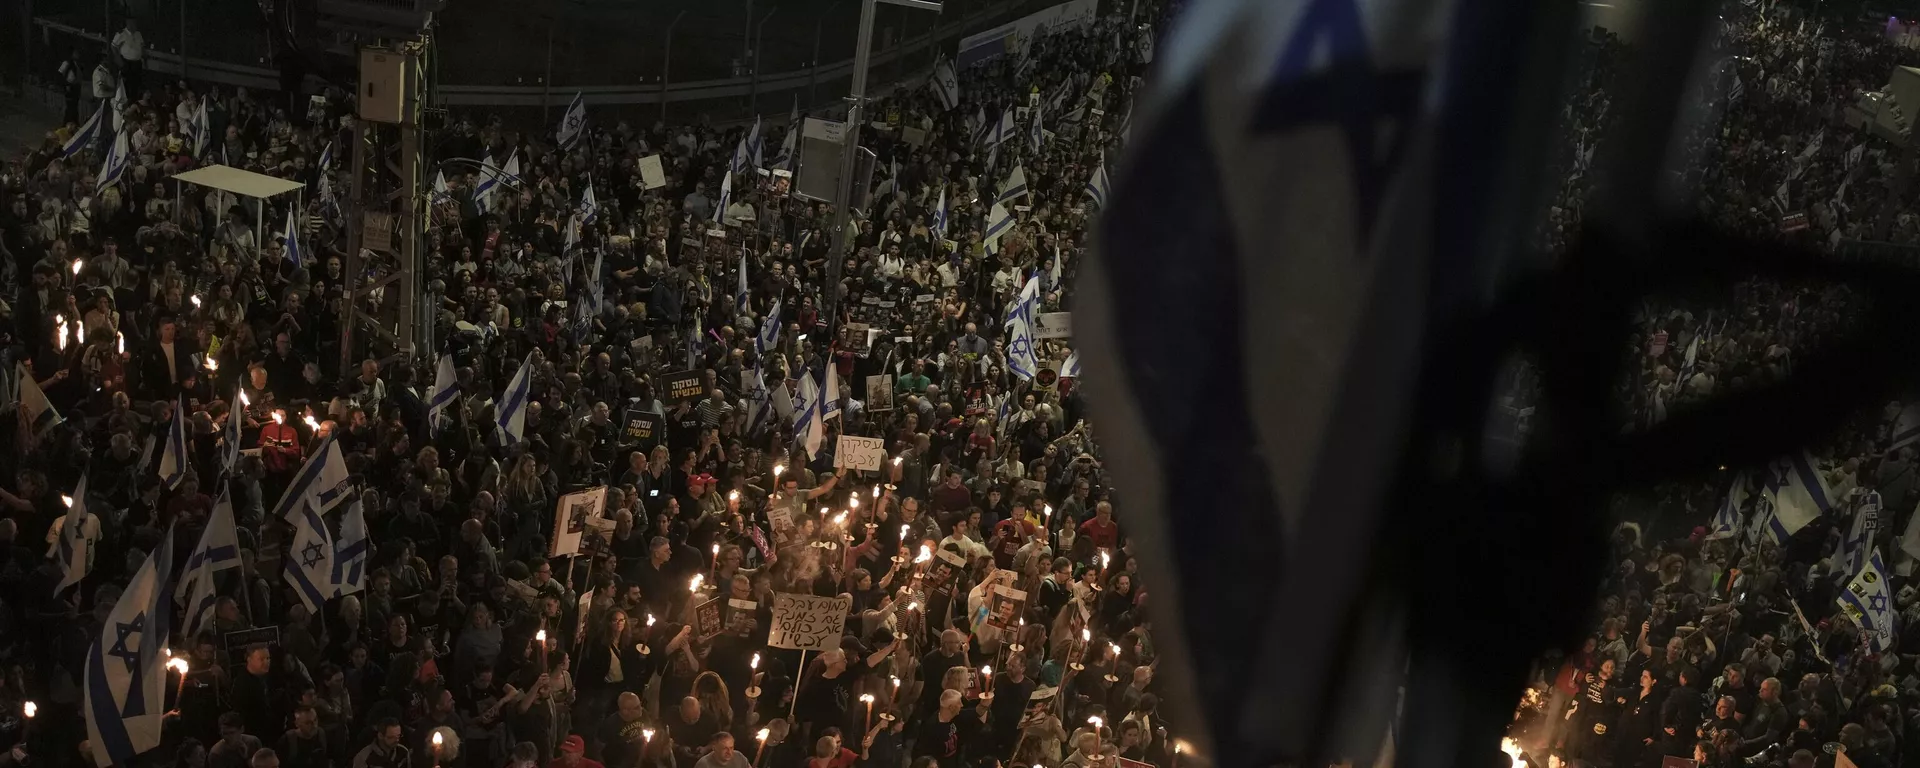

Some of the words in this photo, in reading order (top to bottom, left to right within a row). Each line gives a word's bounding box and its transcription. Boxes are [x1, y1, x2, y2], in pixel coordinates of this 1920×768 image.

[671, 377, 700, 390] עסקה
[671, 386, 702, 399] עכשיו!
[630, 419, 652, 429] עסקה
[627, 428, 652, 438] עכשיו!
[842, 439, 883, 453] עסקה
[821, 615, 840, 625] גם
[812, 624, 842, 635] את
